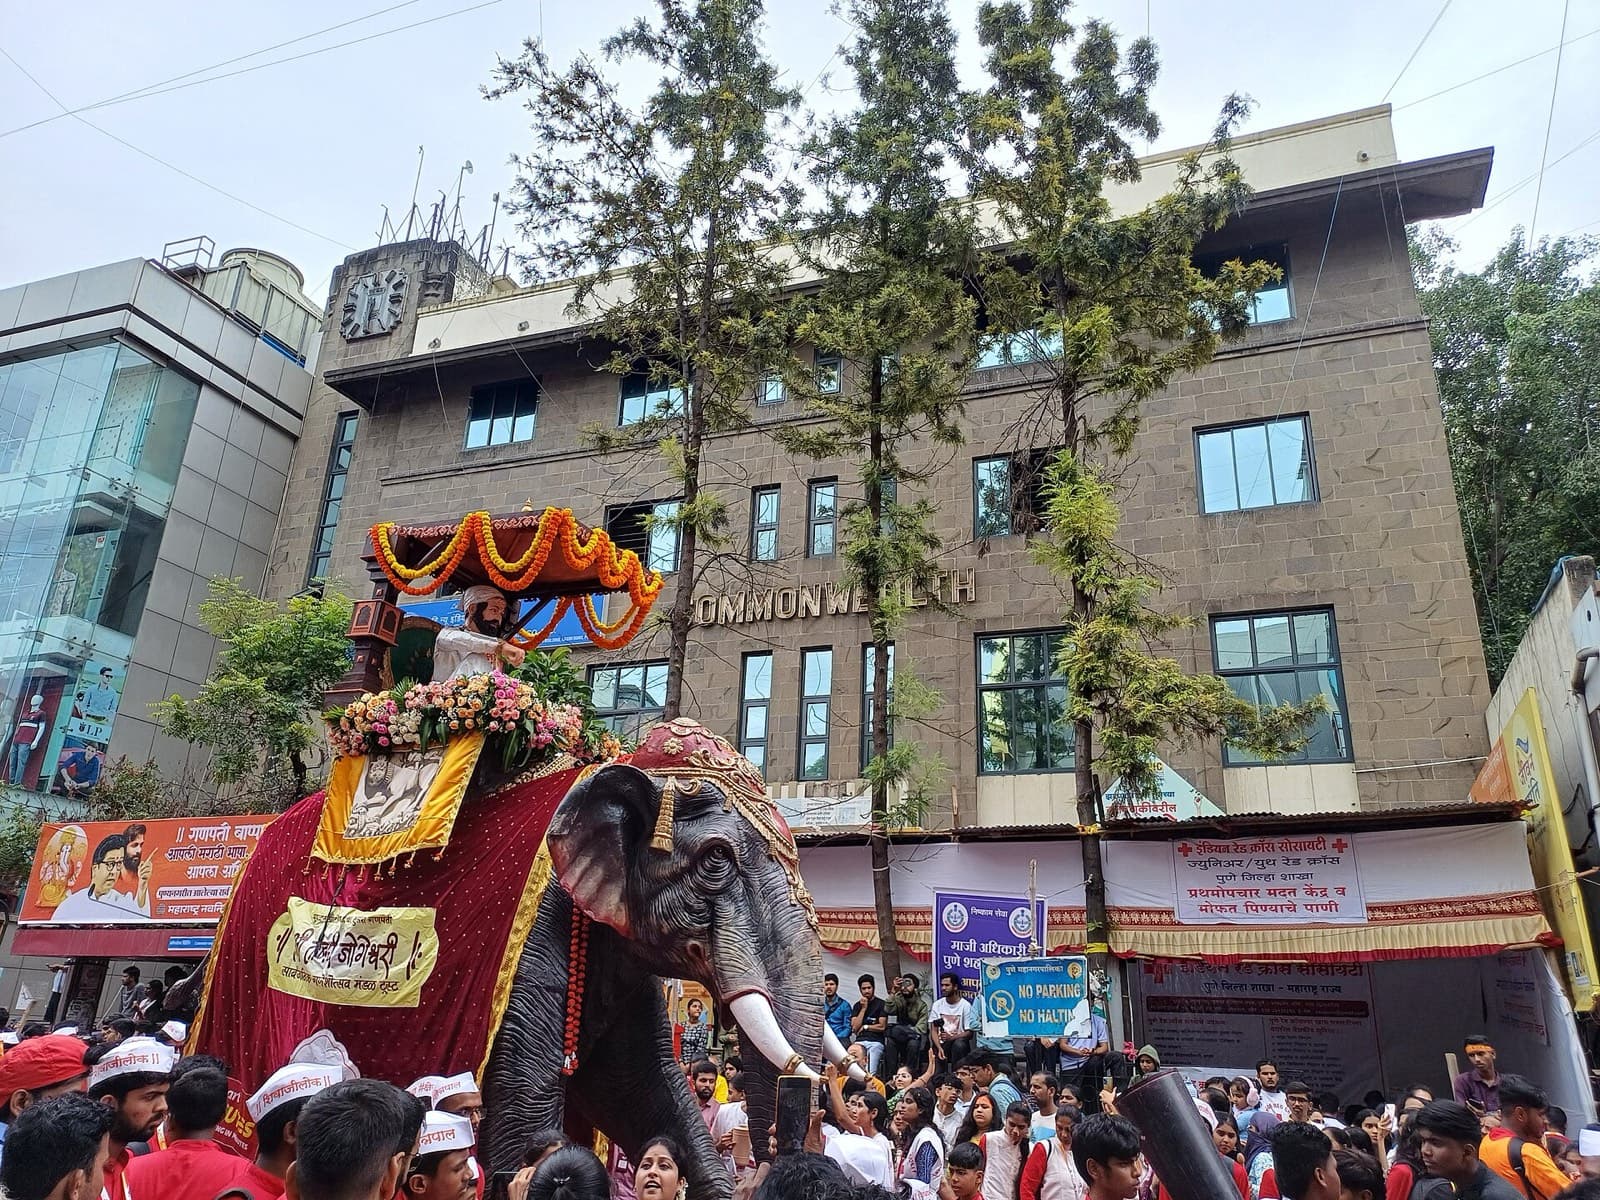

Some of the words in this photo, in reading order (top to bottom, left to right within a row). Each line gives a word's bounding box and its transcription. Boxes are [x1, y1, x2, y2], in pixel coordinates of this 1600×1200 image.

[690, 567, 976, 626] OMMONWELTH
[86, 724, 103, 737] LP
[188, 821, 231, 842] गणपती
[166, 843, 198, 861] आपली
[198, 842, 225, 860] मराठी
[1197, 840, 1230, 855] इंडियन
[1233, 842, 1247, 854] रेड
[1249, 839, 1276, 854] क्रॉस
[1278, 836, 1327, 853] सोसायटी
[1281, 855, 1301, 867] रेड
[1305, 854, 1340, 867] क्रॉस
[186, 864, 219, 879] आपला
[1216, 872, 1237, 884] पुणे
[1242, 873, 1275, 883] जिल्हा
[1280, 872, 1314, 883] शाखा
[1187, 886, 1260, 899] प्रथमोपचार
[1265, 888, 1298, 898] मदत
[1302, 884, 1329, 899] केंद्र
[1334, 887, 1347, 897] व
[1198, 900, 1238, 914] मोफत
[1245, 900, 1298, 914] पिण्याचे
[1303, 900, 1340, 914] पाणी
[951, 937, 977, 951] माजी
[979, 939, 1027, 956] अधिकारी
[943, 953, 961, 970] पुणे
[963, 957, 981, 970] शह
[353, 976, 377, 991] मंडळ
[1018, 984, 1033, 998] NO
[1036, 983, 1081, 998] PARKING
[1019, 1009, 1034, 1023] NO
[1037, 1007, 1076, 1022] HALTIN
[262, 1076, 322, 1108] शिवाजीलोक
